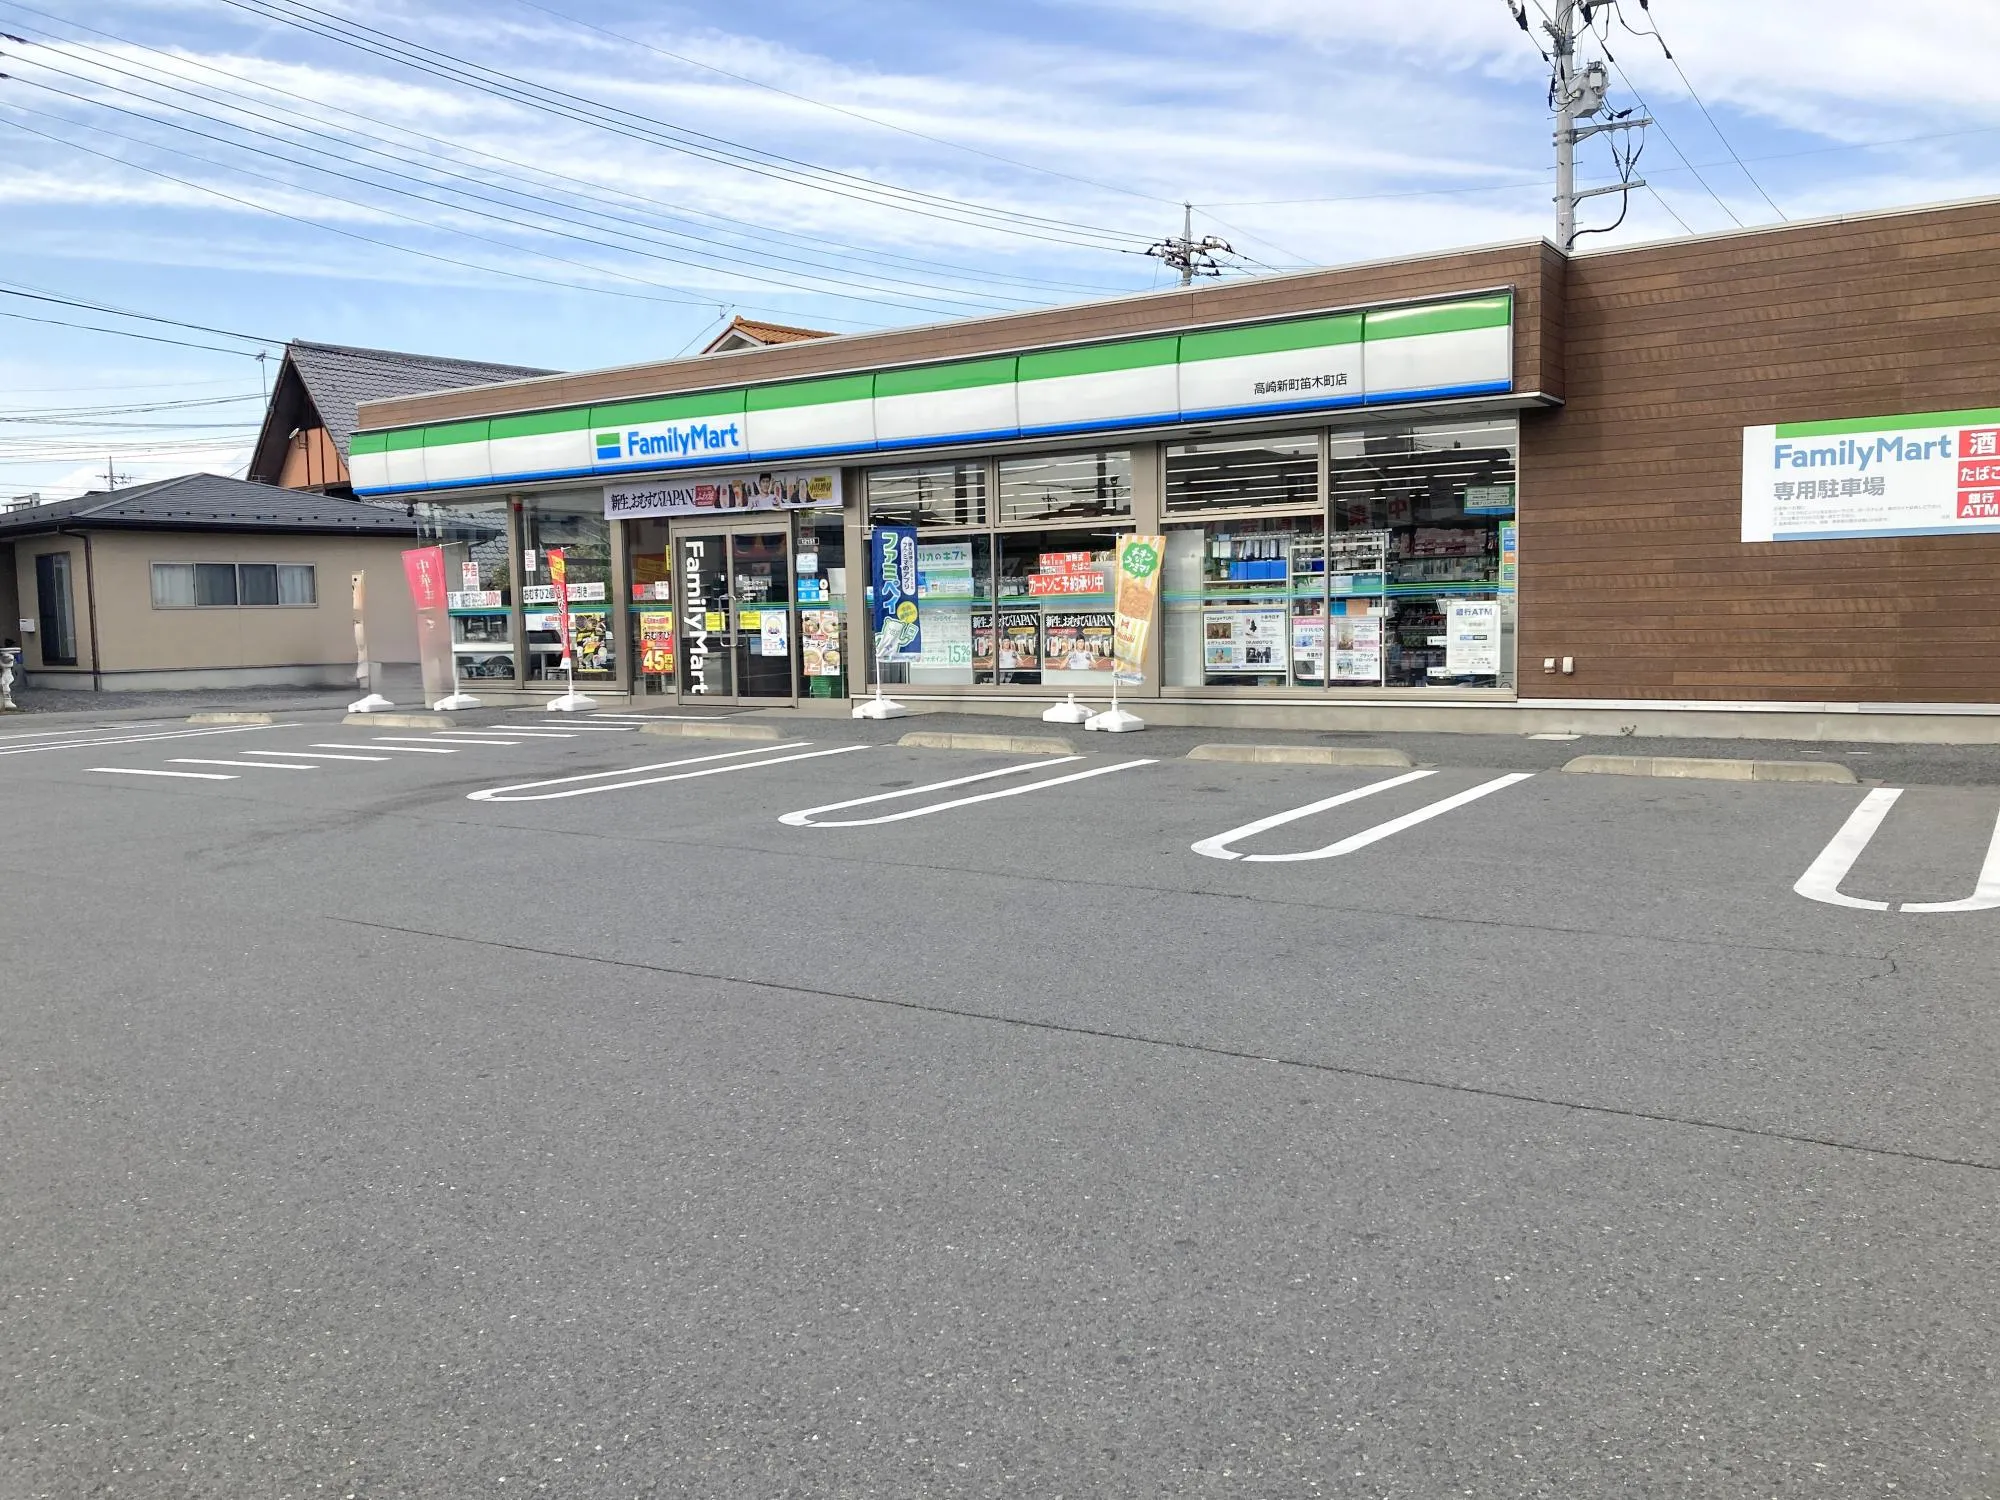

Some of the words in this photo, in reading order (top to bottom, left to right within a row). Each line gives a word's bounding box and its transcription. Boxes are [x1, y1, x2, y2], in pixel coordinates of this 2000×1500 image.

[1254, 372, 1348, 395] 高崎新町笛木町店
[627, 422, 739, 456] FamilyMart
[1969, 432, 1997, 455] 酒
[1774, 434, 1952, 471] FamilyMart
[1774, 476, 1886, 501] 専用駐車場
[1968, 492, 1995, 504] 銀行
[1961, 504, 1999, 518] ATM
[882, 532, 901, 614] ファミペイ
[1072, 562, 1089, 571] たばこ
[1029, 575, 1104, 593] カートンご予約承り中
[683, 541, 709, 694] FamilyMart
